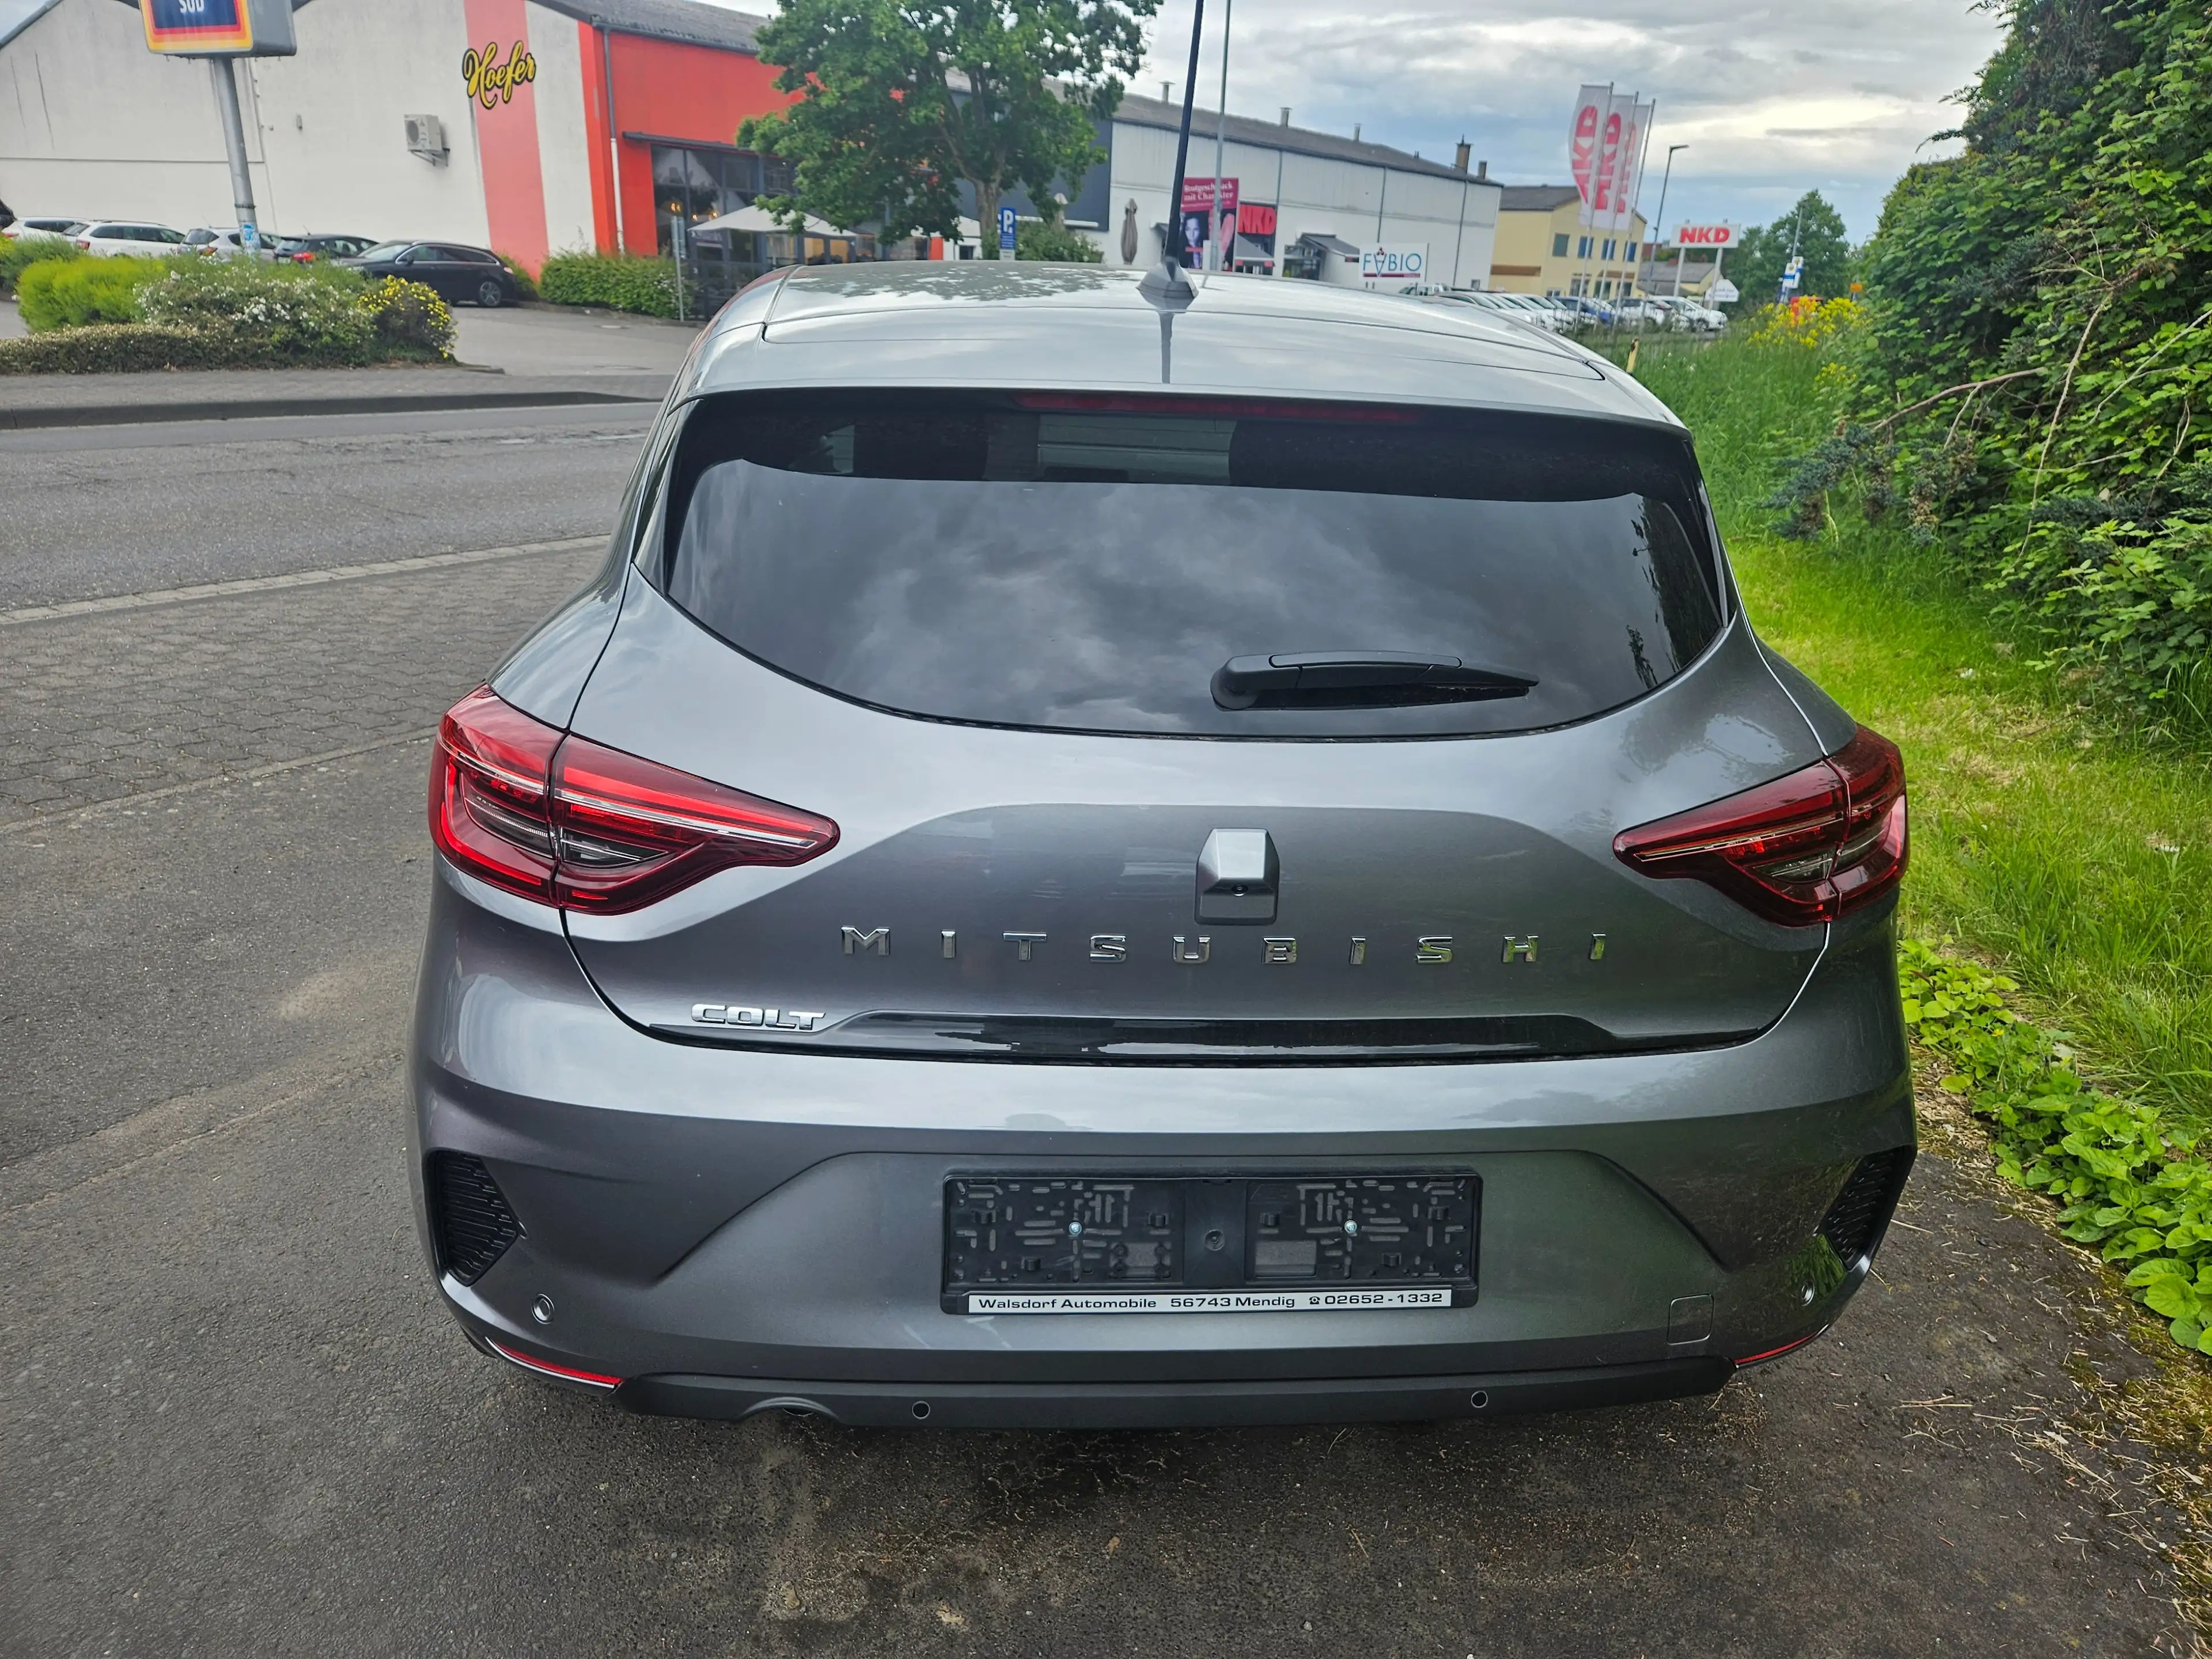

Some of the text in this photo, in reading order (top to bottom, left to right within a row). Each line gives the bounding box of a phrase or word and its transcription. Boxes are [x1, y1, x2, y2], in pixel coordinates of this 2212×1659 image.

[462, 40, 536, 110] Hoefer
[1198, 191, 1234, 201] Charter
[1003, 210, 1014, 232] P
[1237, 204, 1278, 235] NKD
[1679, 227, 1730, 243] NKD
[1363, 253, 1422, 276] FABIO
[840, 925, 1607, 965] MITSUBISHI
[691, 1003, 826, 1031] COLT
[979, 1298, 1057, 1309] Walsdorf
[1060, 1297, 1157, 1309] Automobile
[1171, 1297, 1231, 1308] 56743
[1235, 1296, 1295, 1308] Mendig
